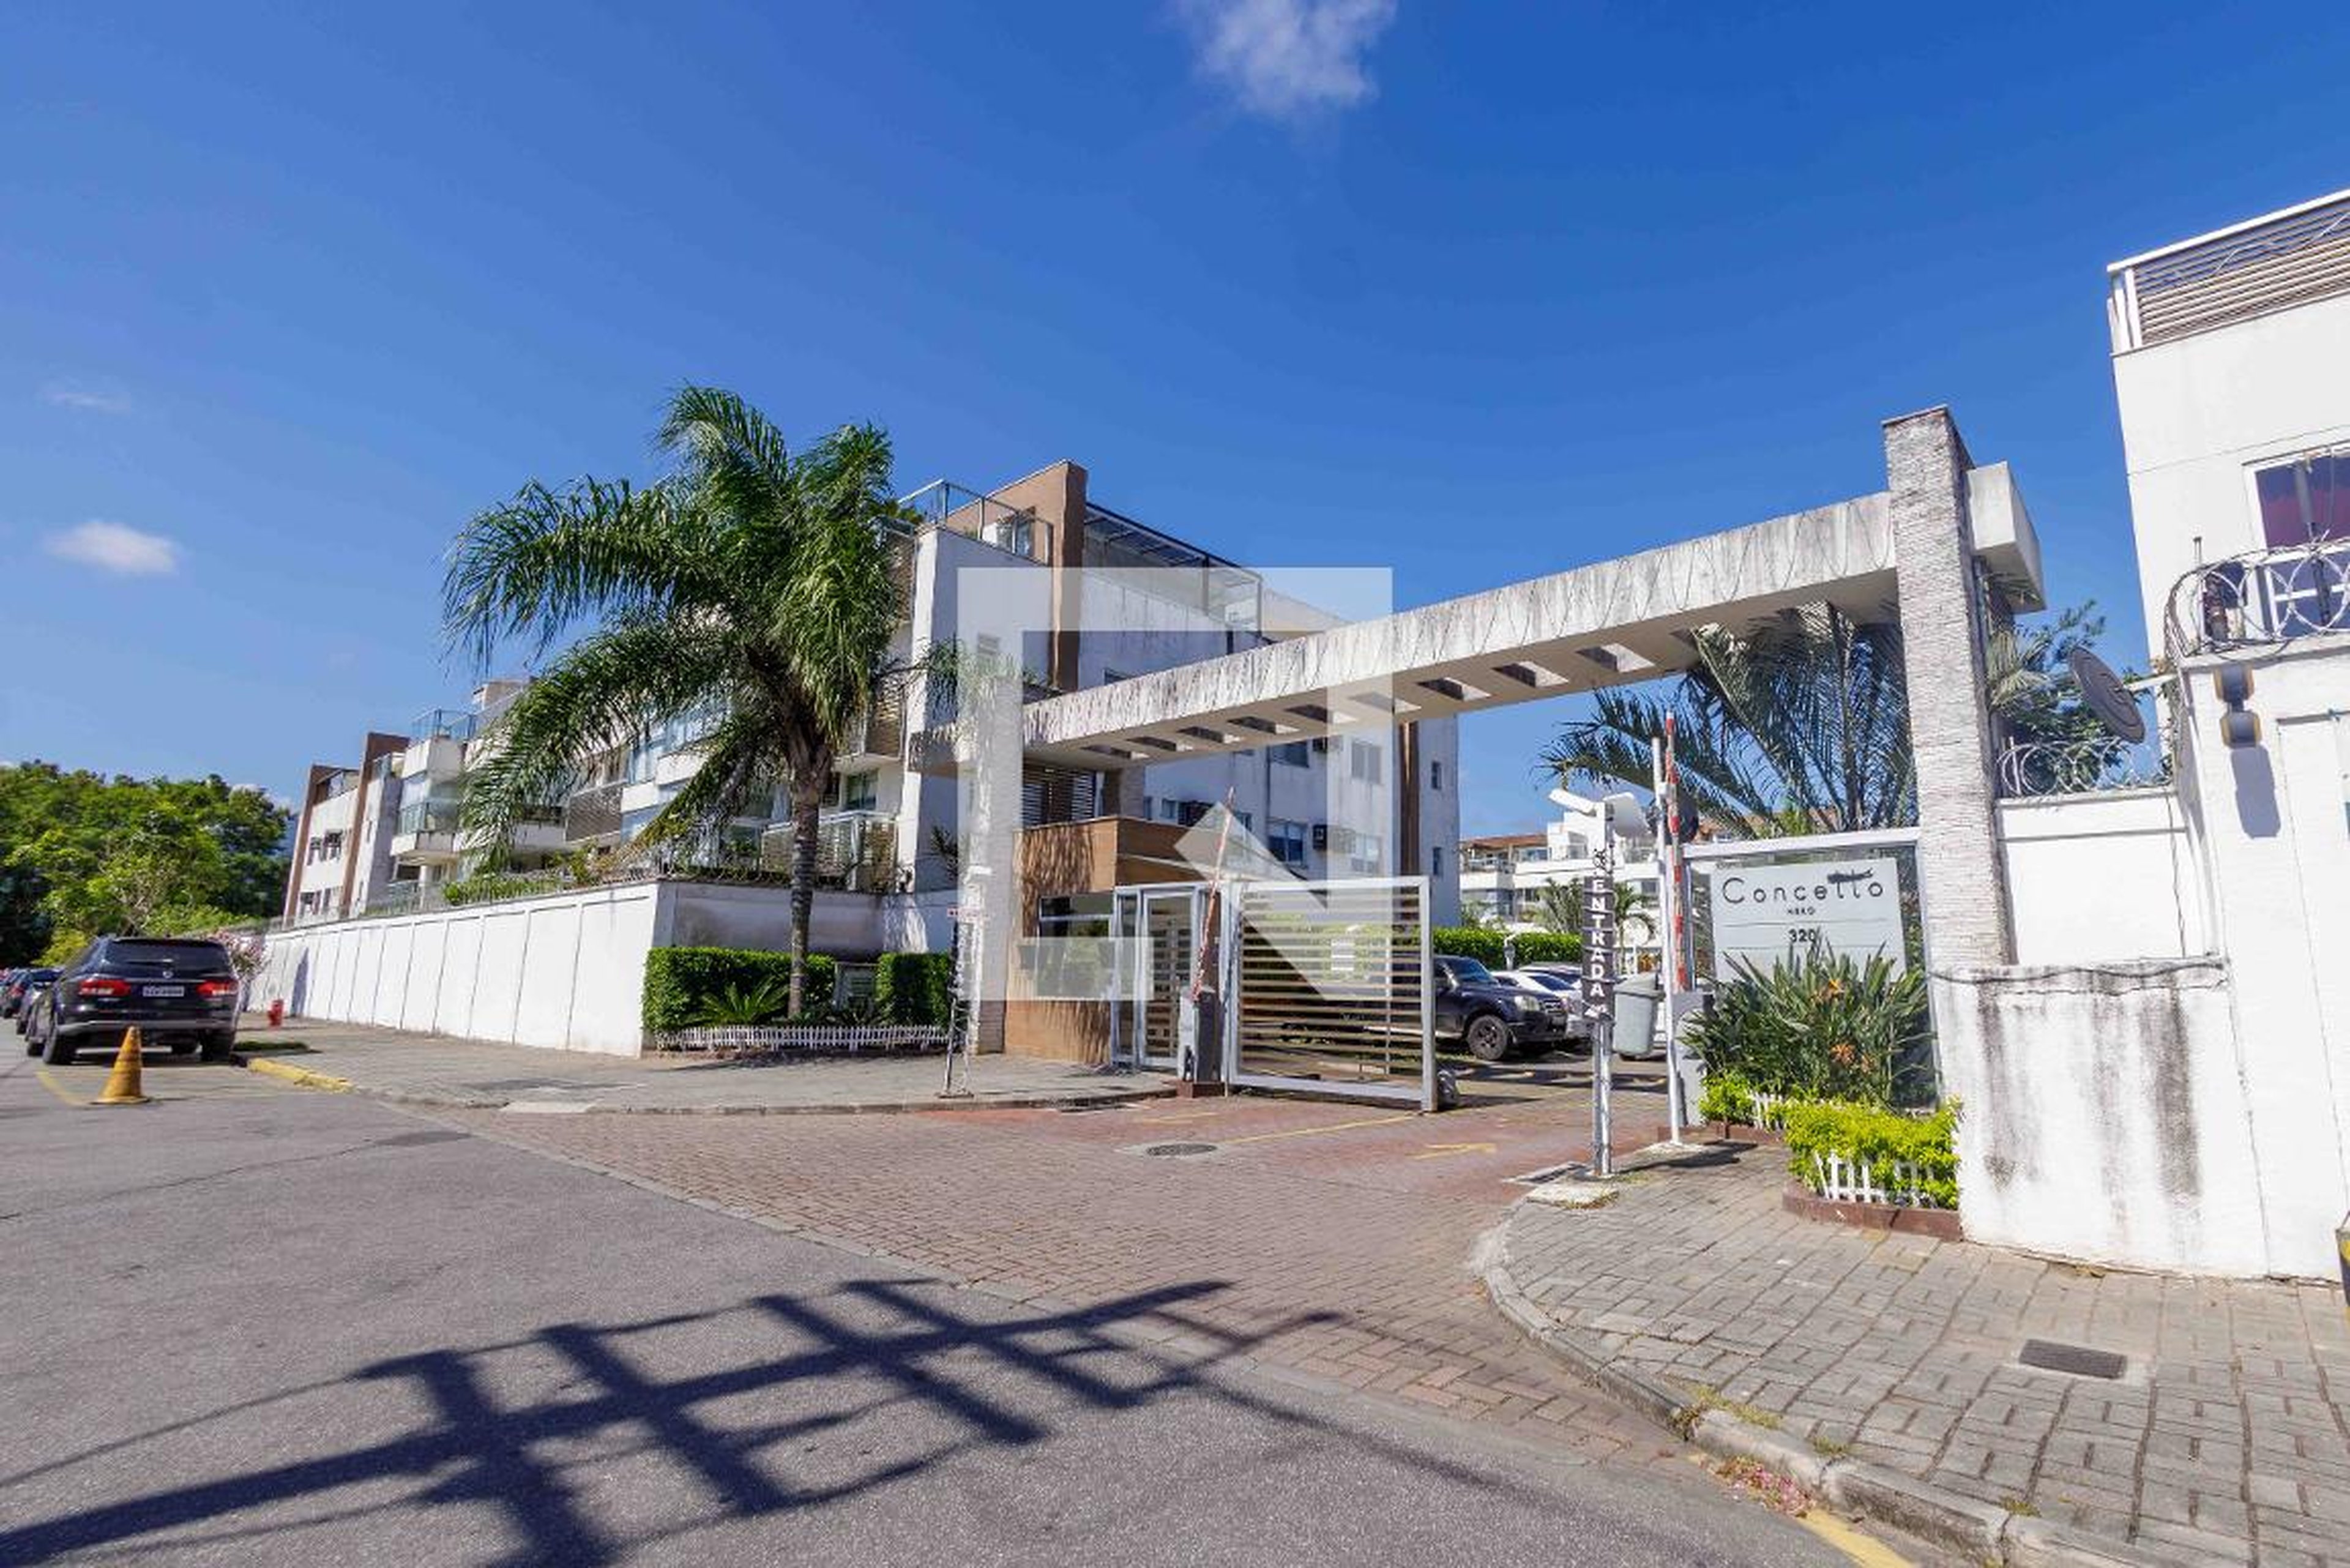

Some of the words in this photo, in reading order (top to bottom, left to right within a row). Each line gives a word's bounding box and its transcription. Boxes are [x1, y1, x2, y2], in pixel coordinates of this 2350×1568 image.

[1723, 870, 1883, 904] Concetto
[1590, 879, 1605, 997] ENTRADA
[1788, 928, 1816, 943] 320
